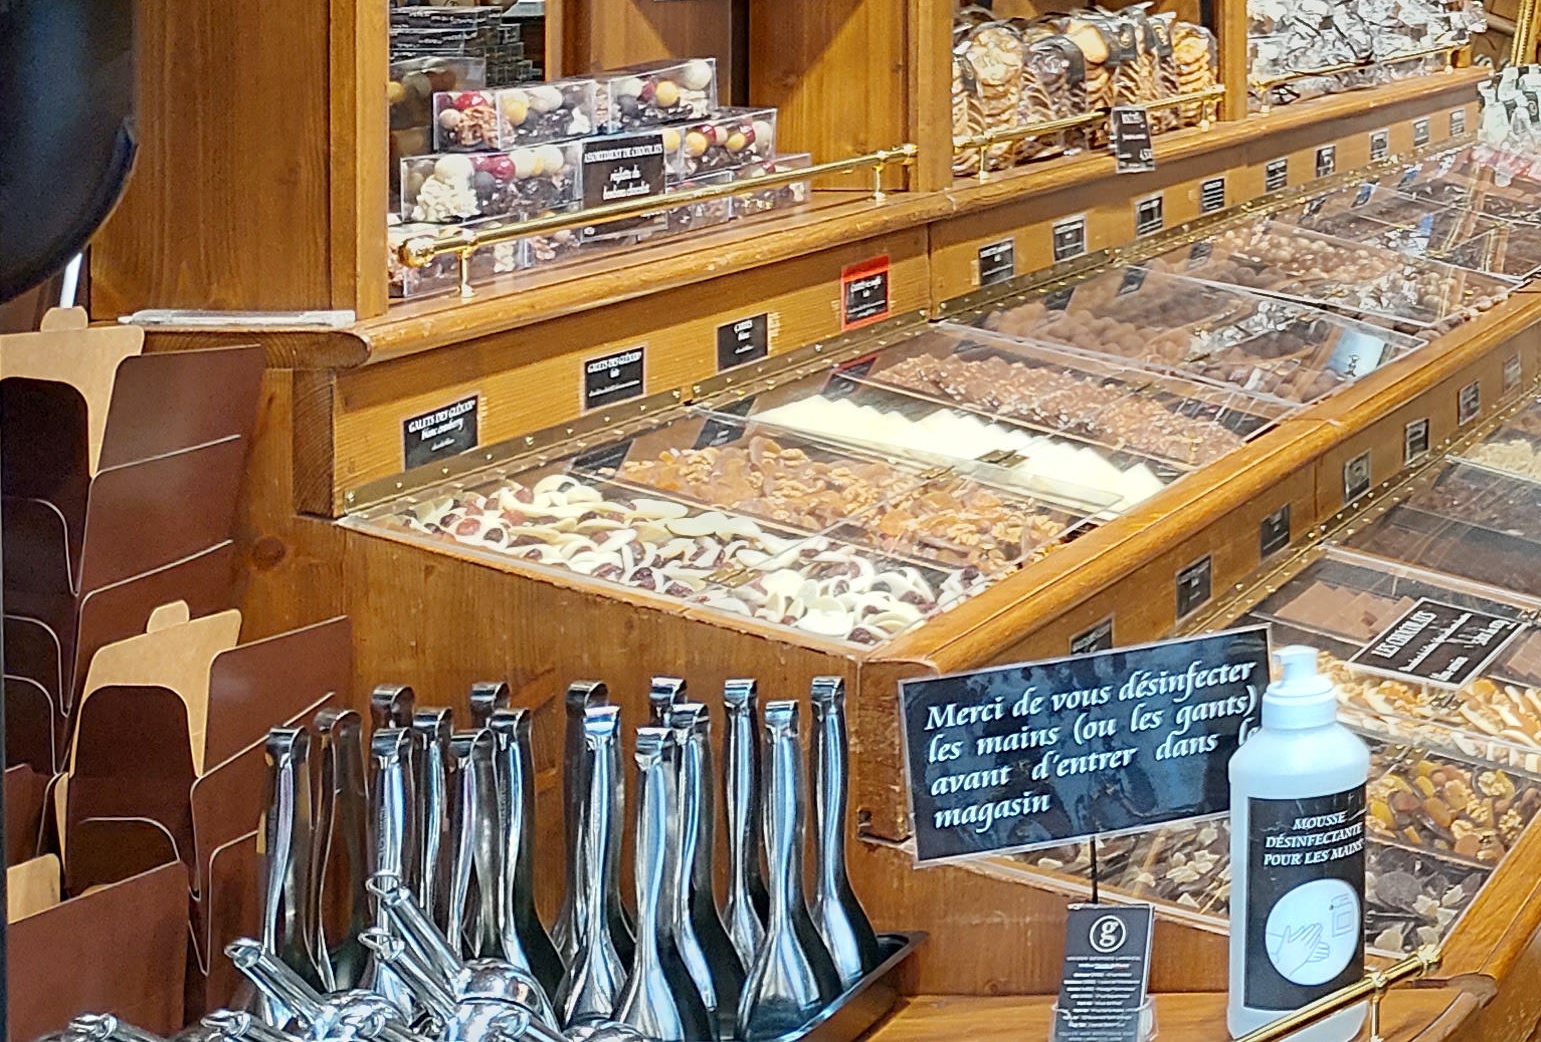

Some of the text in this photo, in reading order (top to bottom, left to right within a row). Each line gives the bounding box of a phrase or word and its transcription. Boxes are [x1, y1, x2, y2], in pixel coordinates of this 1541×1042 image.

[924, 661, 1257, 731] Merci de vous désinfecter
[928, 686, 1258, 764] les mains (ou les gants)
[931, 766, 1011, 796] avant
[1031, 748, 1137, 781] d'entrer
[1156, 731, 1220, 762] dans
[934, 792, 1051, 833] magasin
[1292, 810, 1348, 831] MOUSSE
[1264, 838, 1364, 866] POUR LES MAINS
[1265, 822, 1363, 848] DÉSINFECTANTE
[1099, 921, 1119, 947] g
